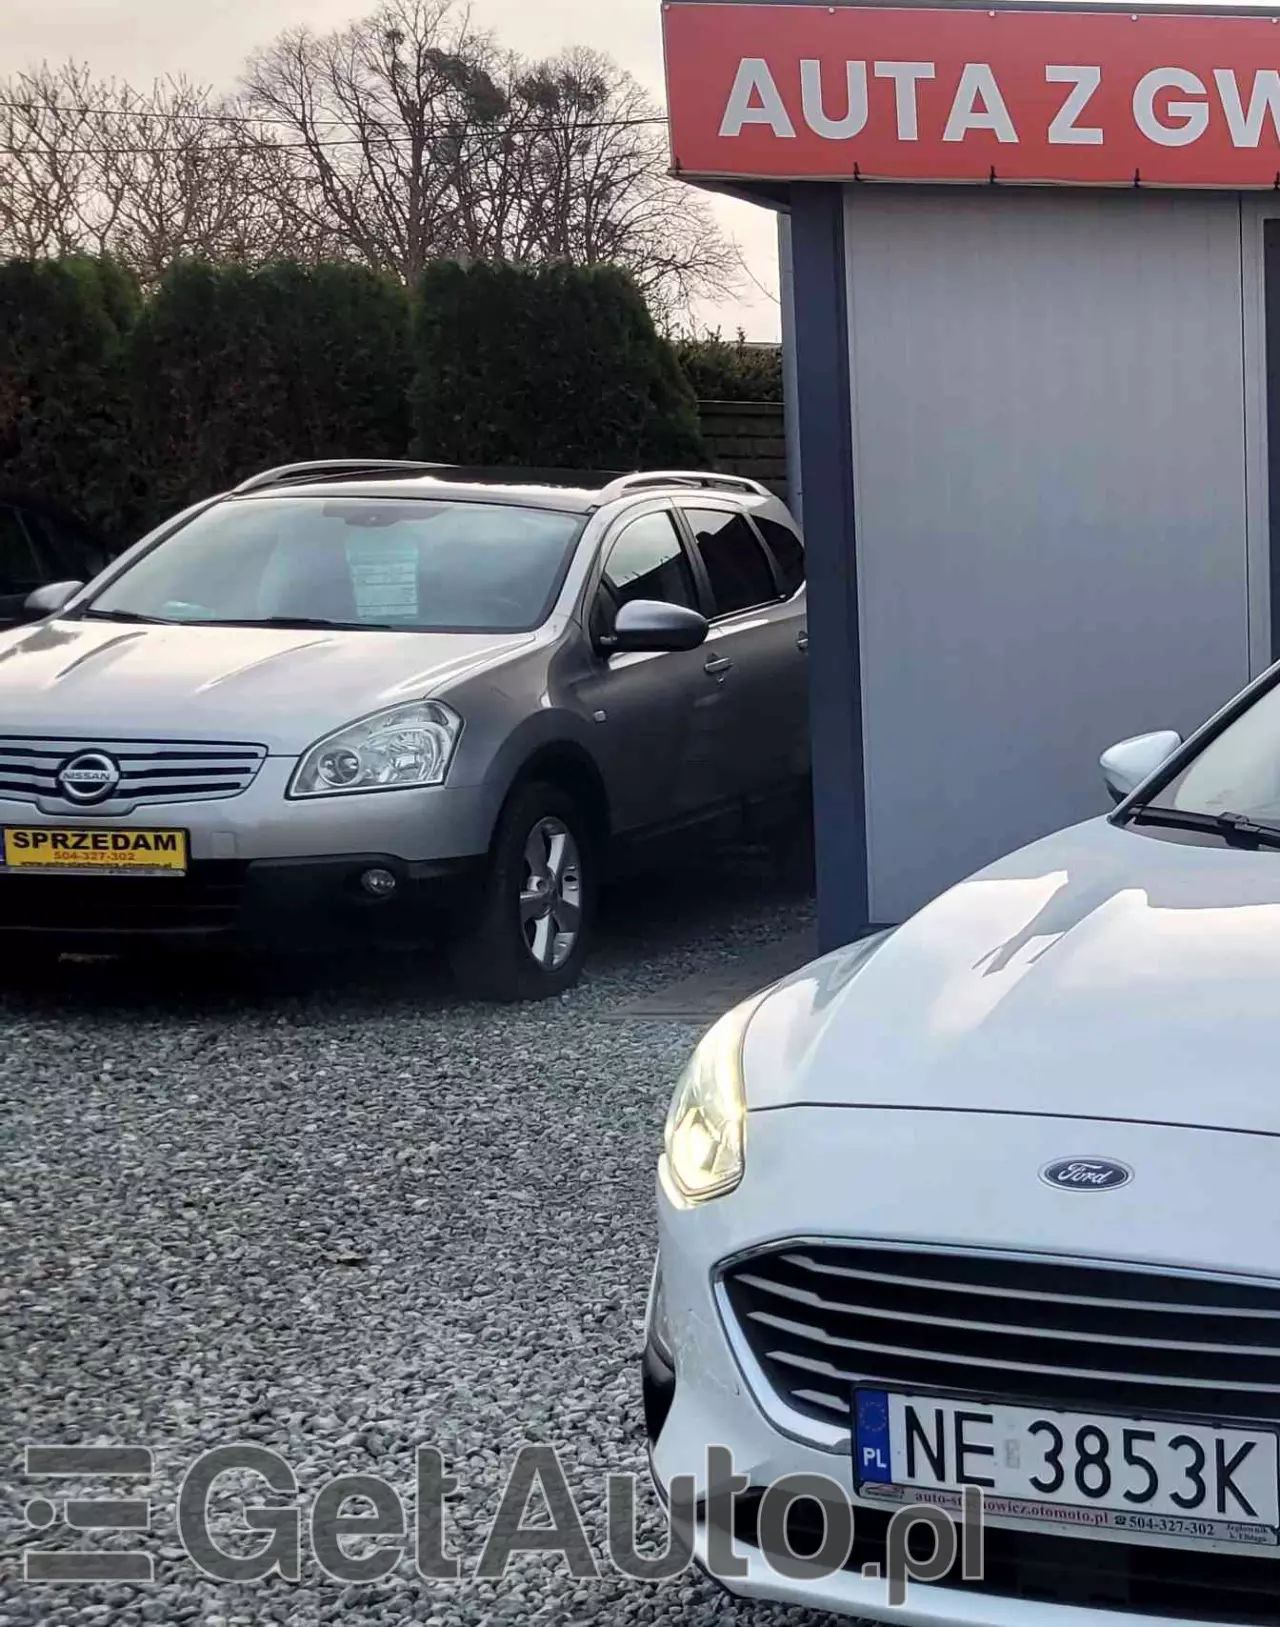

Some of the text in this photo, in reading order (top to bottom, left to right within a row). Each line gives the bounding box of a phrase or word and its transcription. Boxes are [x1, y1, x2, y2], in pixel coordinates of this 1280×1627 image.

[719, 58, 1019, 142] AUTA
[1045, 65, 1103, 144] Z
[62, 772, 111, 781] NISSAN
[13, 832, 177, 851] SPRZEDAM
[1058, 1163, 1113, 1183] Ford
[863, 1448, 887, 1468] PL
[905, 1406, 1258, 1517] NE 3853K
[1129, 1515, 1216, 1536] 504-327-302
